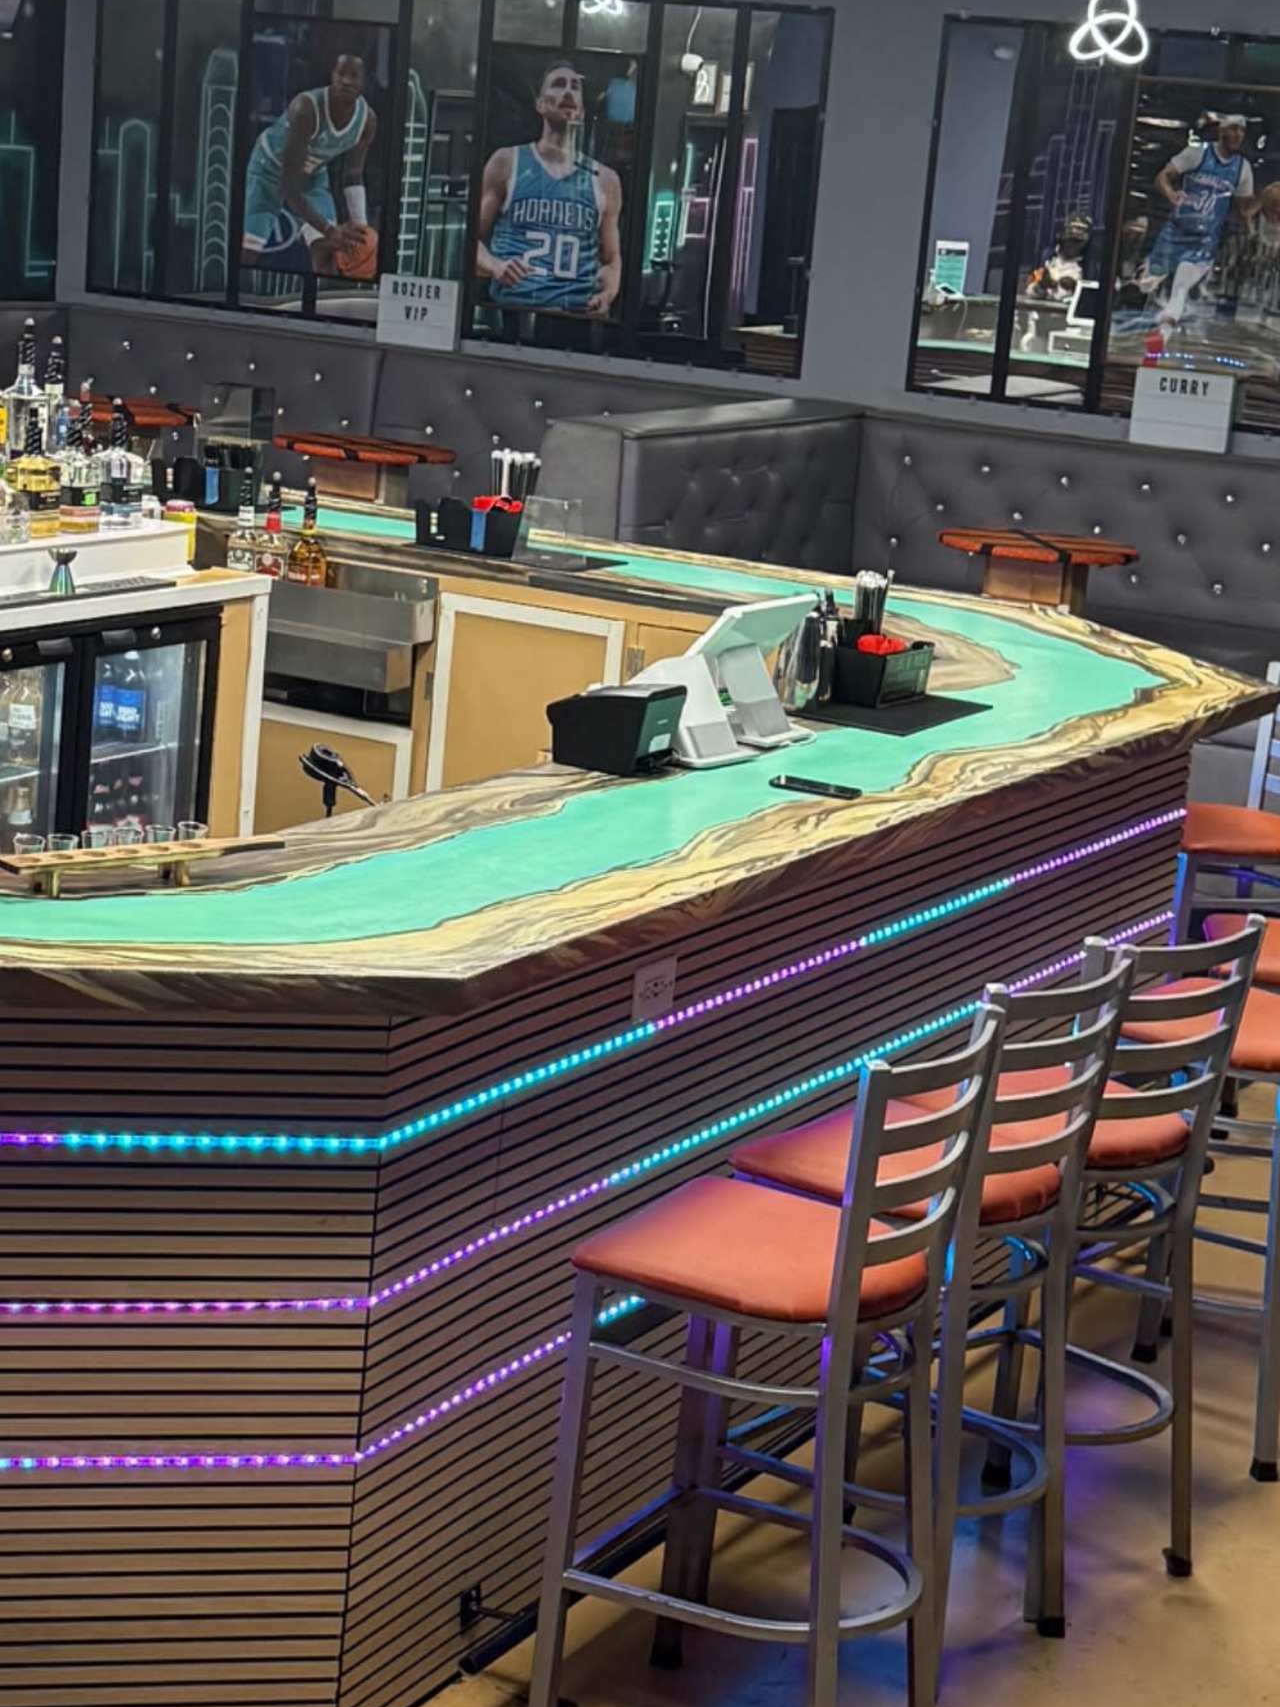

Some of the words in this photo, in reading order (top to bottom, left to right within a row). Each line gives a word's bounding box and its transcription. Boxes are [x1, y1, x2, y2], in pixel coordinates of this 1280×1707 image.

[513, 197, 596, 231] HORNETS
[522, 231, 580, 279] 20
[392, 280, 441, 300] ROZIER
[404, 305, 428, 321] VIP
[1159, 377, 1210, 396] CURRY
